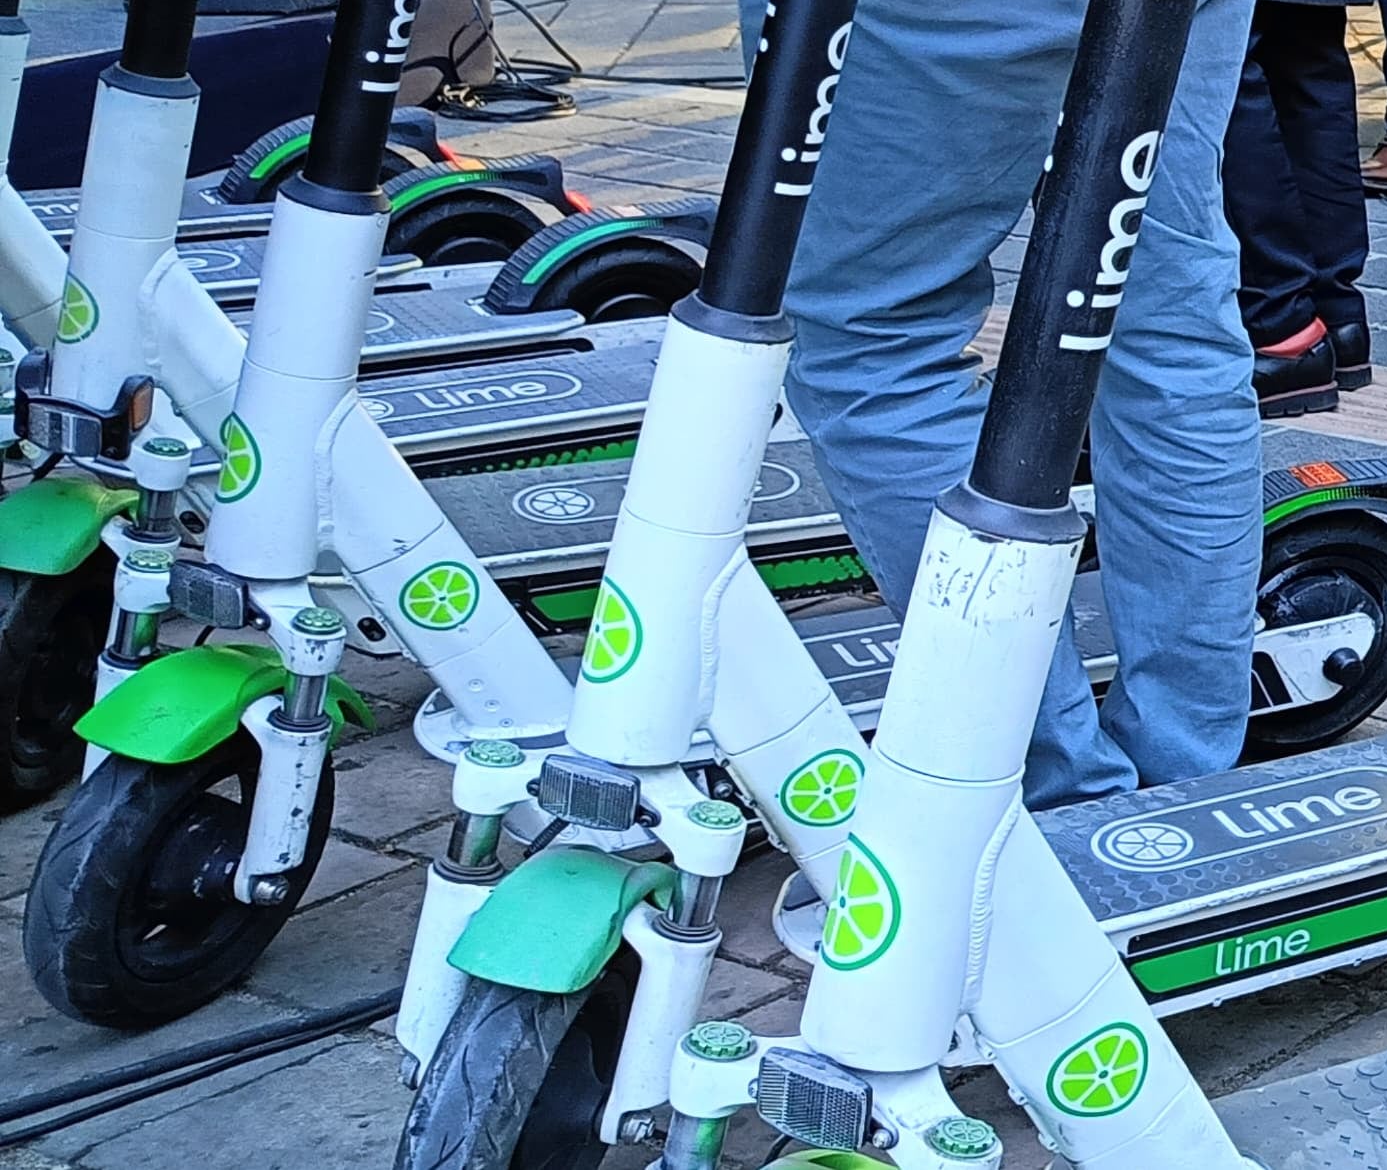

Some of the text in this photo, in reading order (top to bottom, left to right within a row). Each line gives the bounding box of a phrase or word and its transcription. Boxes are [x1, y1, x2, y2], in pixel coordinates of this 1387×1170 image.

[414, 381, 547, 408] Lime
[832, 637, 900, 667] Li
[1211, 786, 1382, 838] Lime
[1215, 929, 1311, 976] Lime
